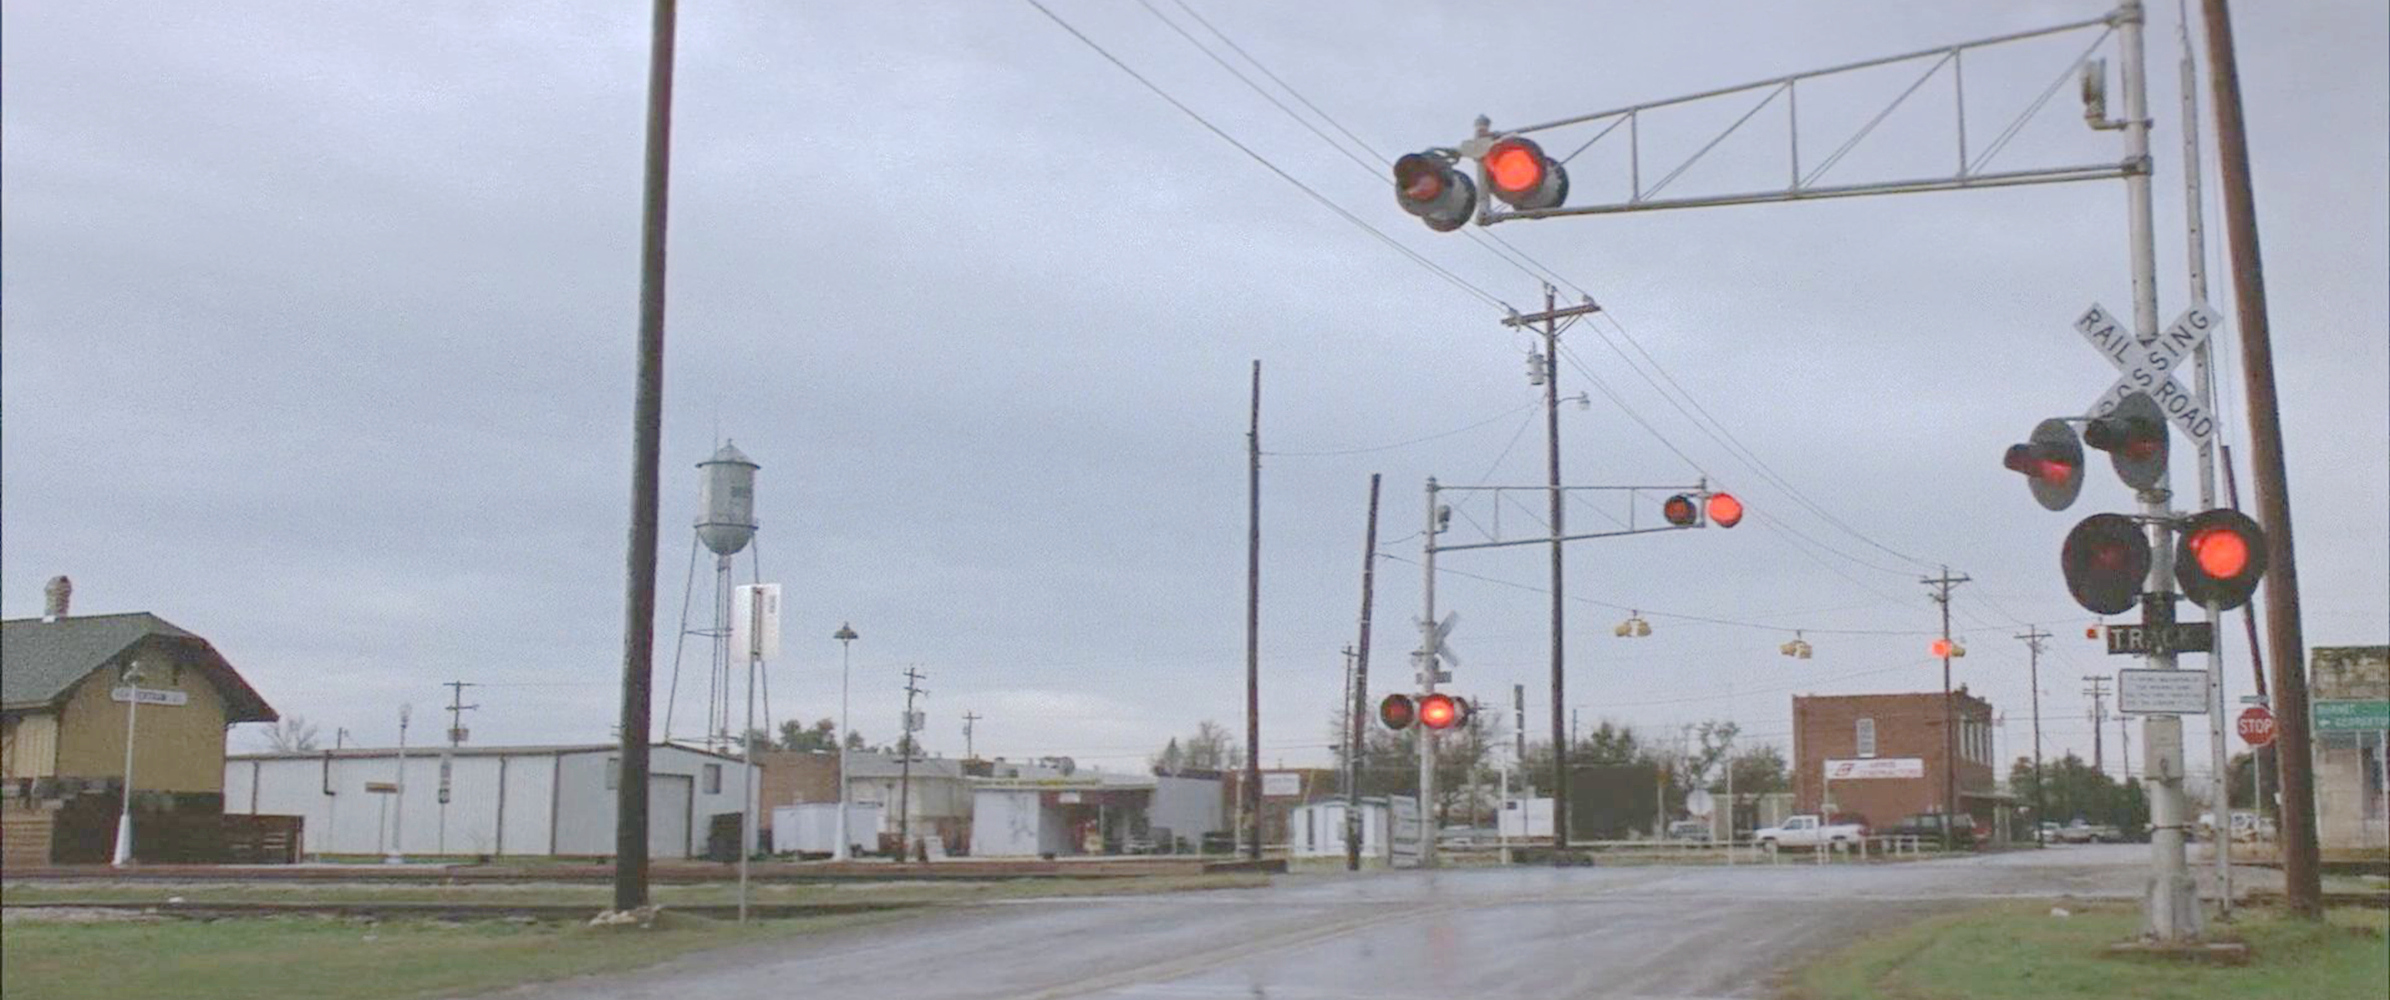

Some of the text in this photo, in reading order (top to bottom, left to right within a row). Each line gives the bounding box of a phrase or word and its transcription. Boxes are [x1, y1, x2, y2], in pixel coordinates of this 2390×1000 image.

[2080, 309, 2213, 438] RAIL ROAD
[2239, 718, 2273, 735] STOP
